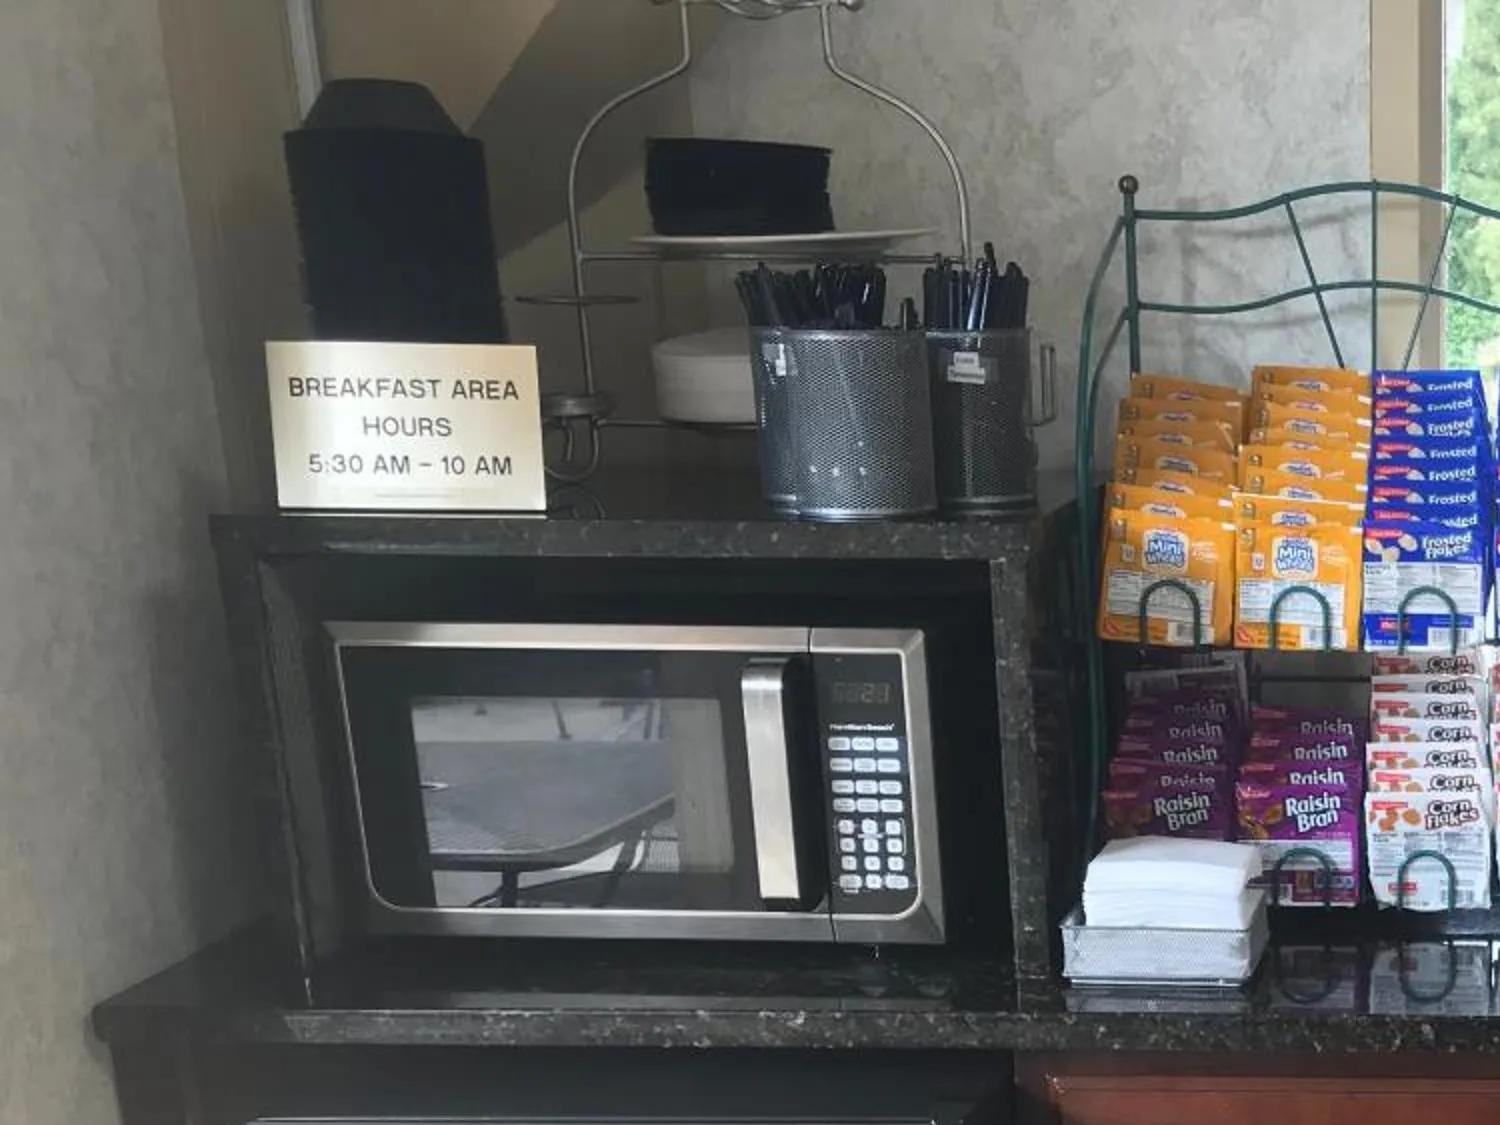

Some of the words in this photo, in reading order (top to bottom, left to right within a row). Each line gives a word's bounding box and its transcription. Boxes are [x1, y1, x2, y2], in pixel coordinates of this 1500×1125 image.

[288, 377, 442, 399] BREAKFAST
[451, 379, 519, 400] AREA
[362, 416, 452, 437] HOURS
[1428, 417, 1474, 432] Frosted
[308, 453, 364, 474] 5:30
[373, 455, 411, 475] AM
[442, 456, 466, 475] 10
[475, 455, 513, 476] AM
[1149, 539, 1182, 555] Mini
[1422, 531, 1472, 551] Frosted
[1279, 546, 1312, 560] Mini
[1427, 655, 1468, 671] Corn
[1425, 679, 1466, 695] Corn
[1427, 700, 1469, 716] Corn
[1428, 725, 1471, 742] Corn
[1294, 741, 1348, 761] Raisin
[1426, 749, 1467, 766] Corn
[1289, 767, 1345, 785] Raisin
[1430, 774, 1475, 791] Corn
[1153, 791, 1211, 817] Raisin
[1285, 791, 1341, 818] Raisin
[1427, 798, 1473, 816] Corn
[1166, 806, 1209, 832] Bran
[1295, 806, 1339, 833] Bran
